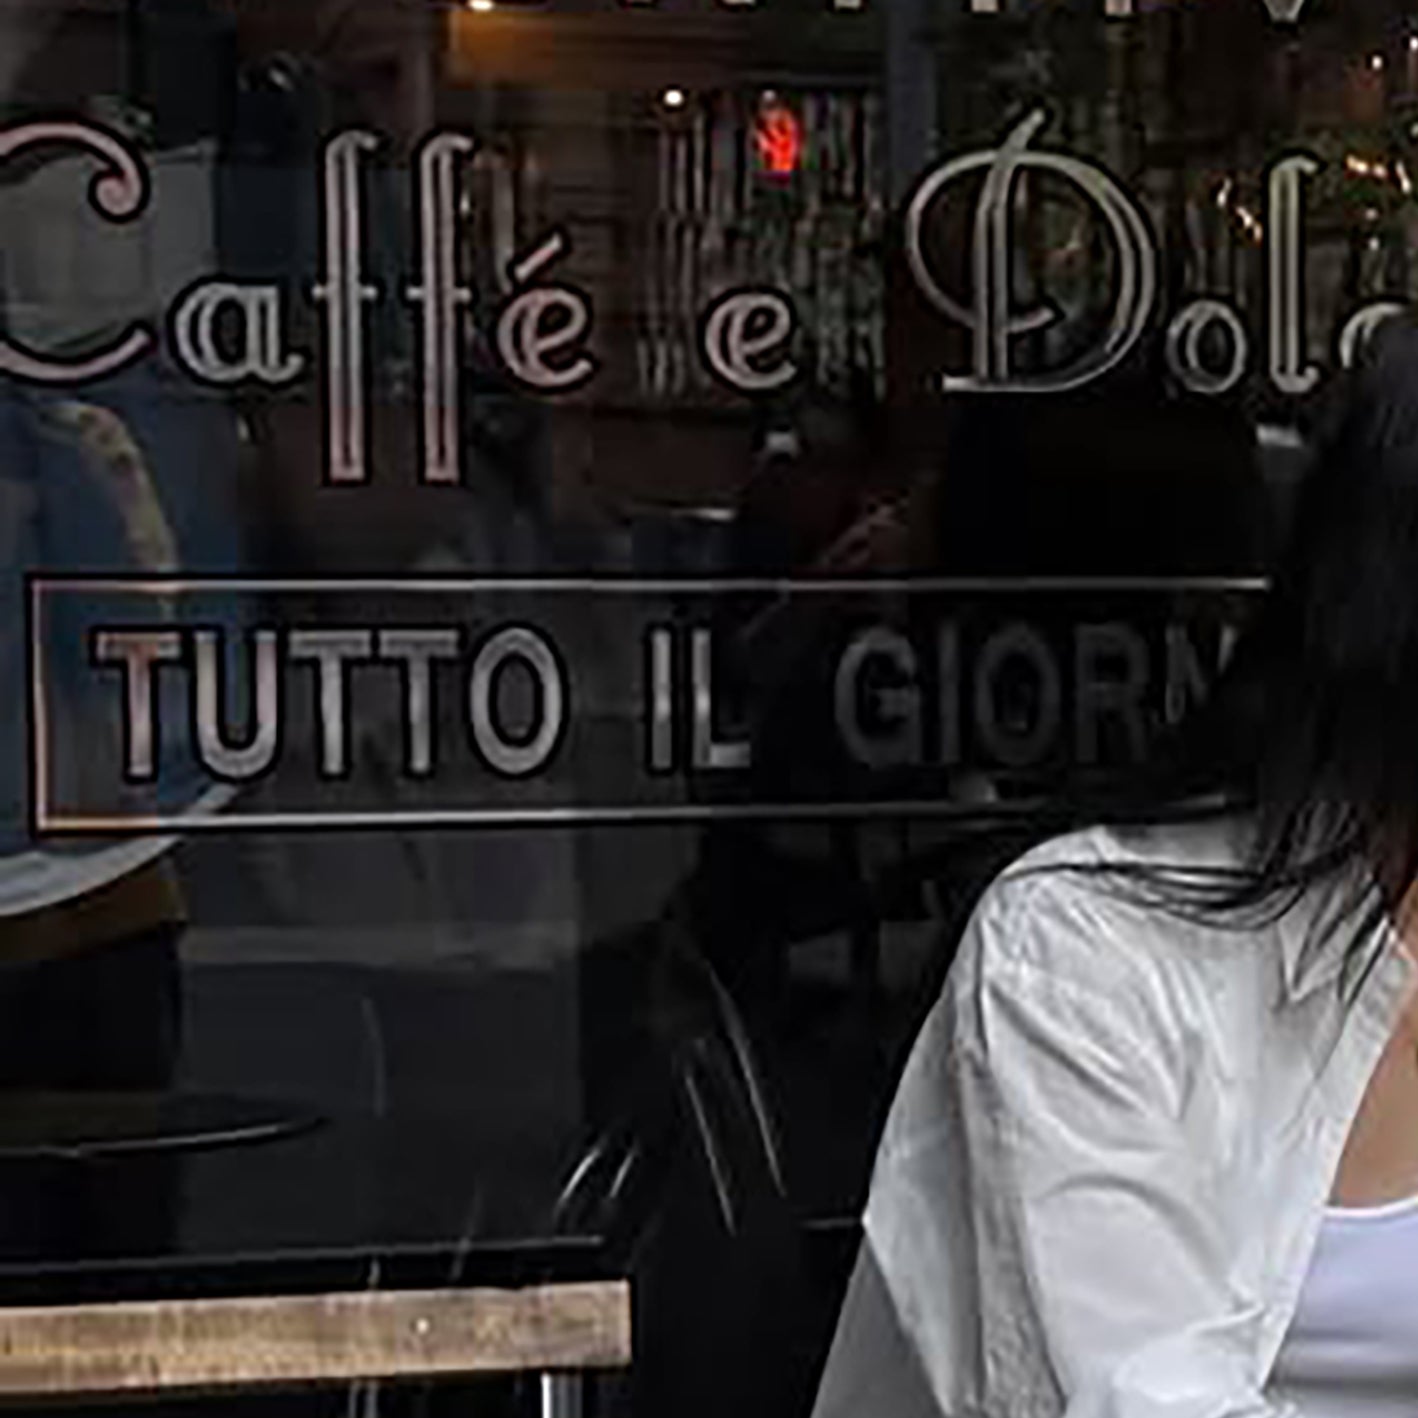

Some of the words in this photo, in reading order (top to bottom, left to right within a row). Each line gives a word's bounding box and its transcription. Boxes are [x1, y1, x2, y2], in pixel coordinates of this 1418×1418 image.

[0, 120, 594, 482] Caffé
[704, 292, 796, 389] e
[97, 628, 563, 776] TUTTO
[651, 629, 751, 769] IL
[833, 618, 1241, 769] GIORN
